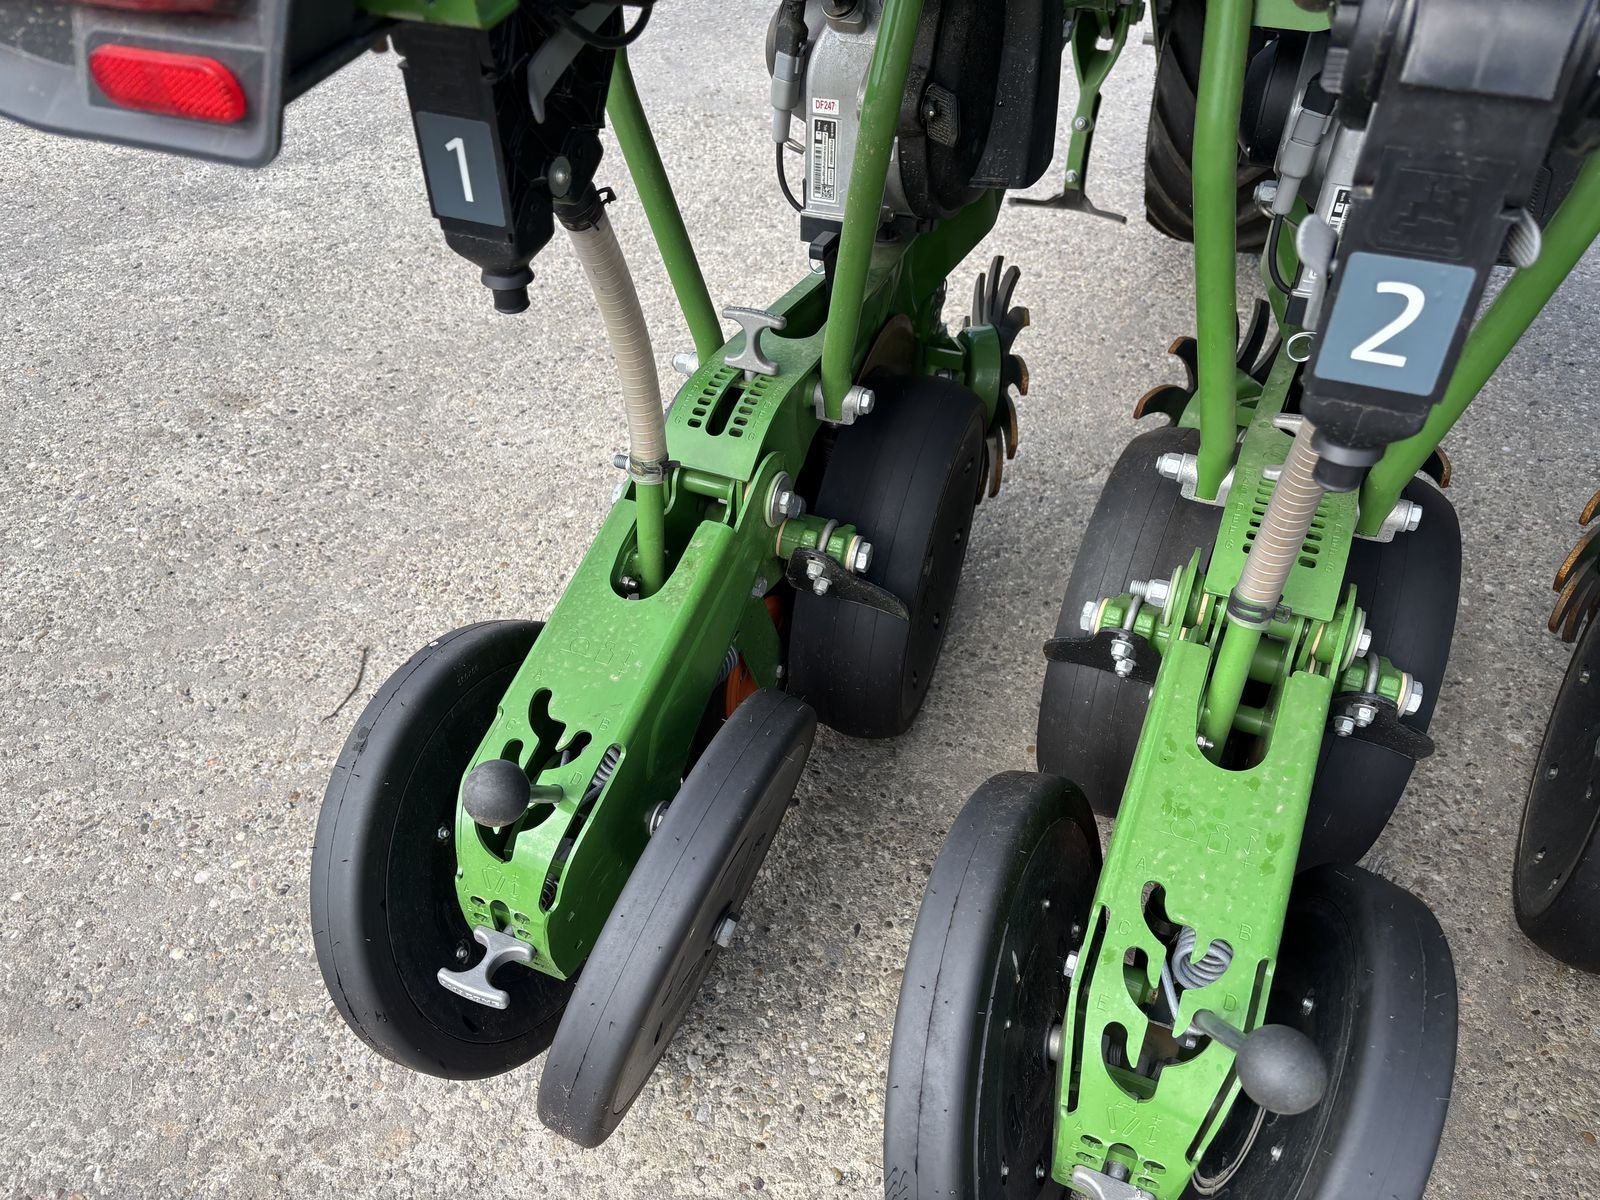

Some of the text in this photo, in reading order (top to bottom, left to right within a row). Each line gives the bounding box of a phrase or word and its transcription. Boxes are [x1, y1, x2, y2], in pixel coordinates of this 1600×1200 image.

[815, 99, 836, 111] DF247
[444, 136, 474, 203] 1
[1350, 280, 1426, 368] 2
[570, 772, 583, 784] D
[1136, 856, 1147, 871] A
[1118, 920, 1132, 936] C
[1239, 923, 1254, 941] B
[1097, 994, 1111, 1011] E
[1224, 993, 1238, 1011] D
